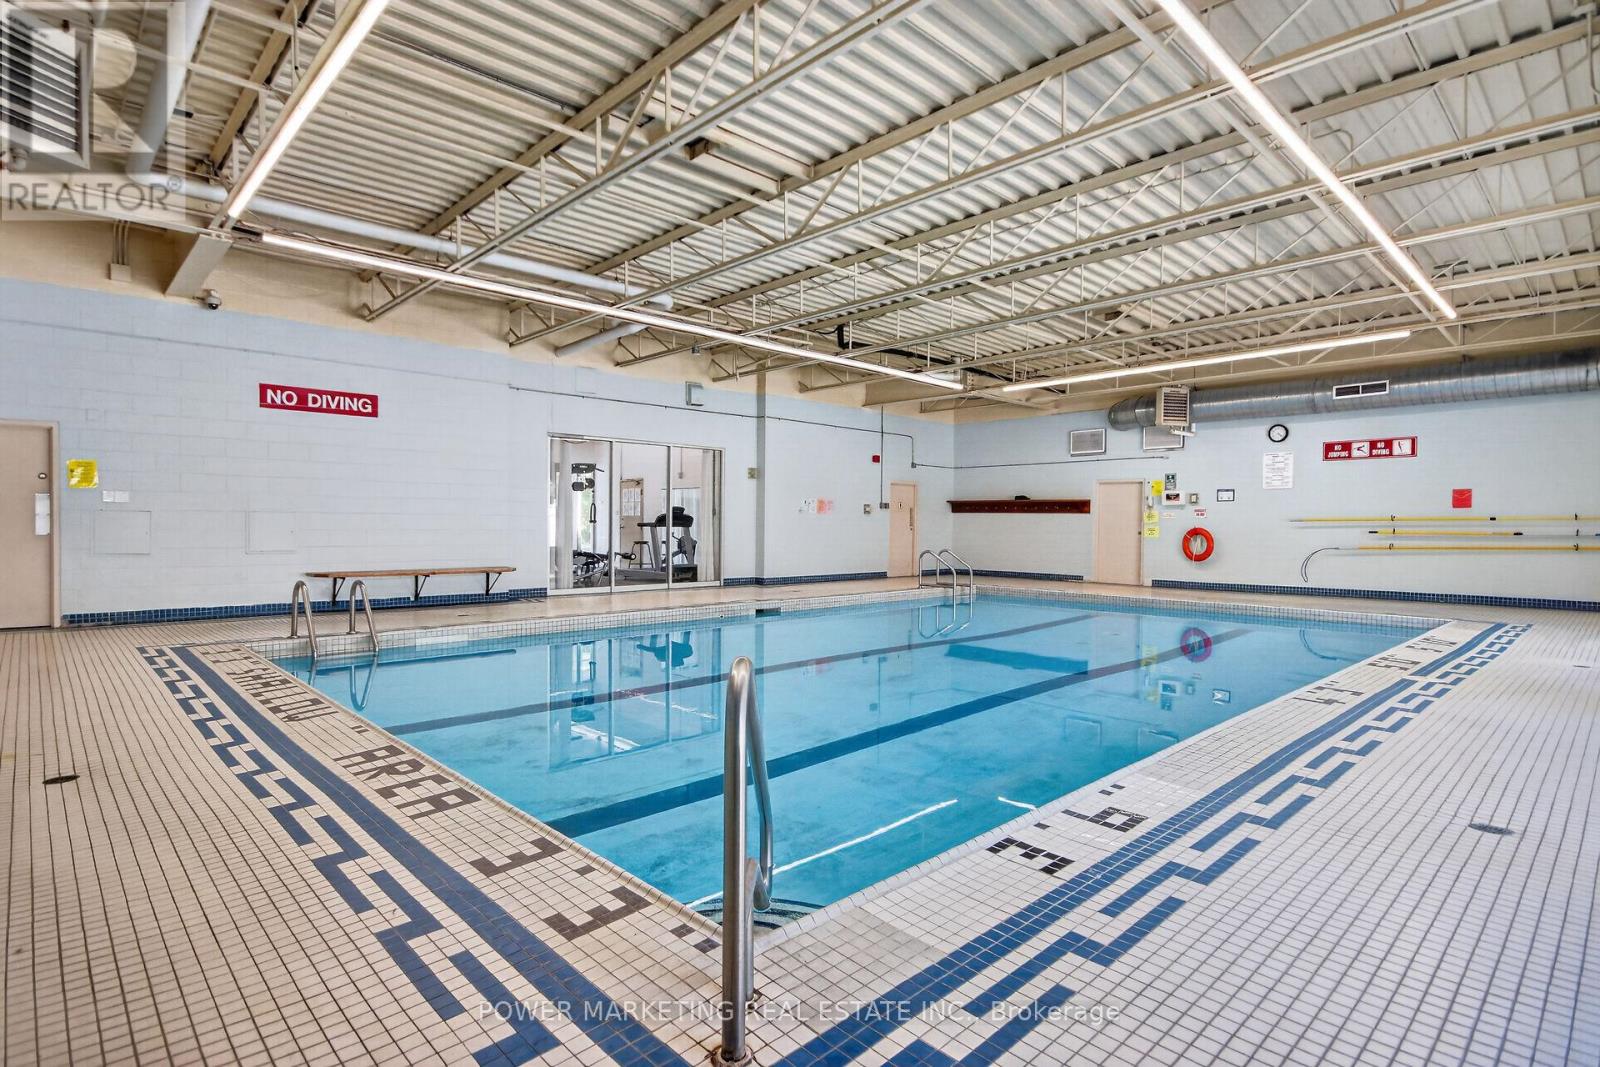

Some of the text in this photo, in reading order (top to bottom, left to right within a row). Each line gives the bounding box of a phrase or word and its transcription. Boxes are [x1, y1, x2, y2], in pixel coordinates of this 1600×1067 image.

[266, 388, 372, 413] NO DIVING
[1376, 441, 1385, 449] NO
[333, 744, 482, 820] AREA
